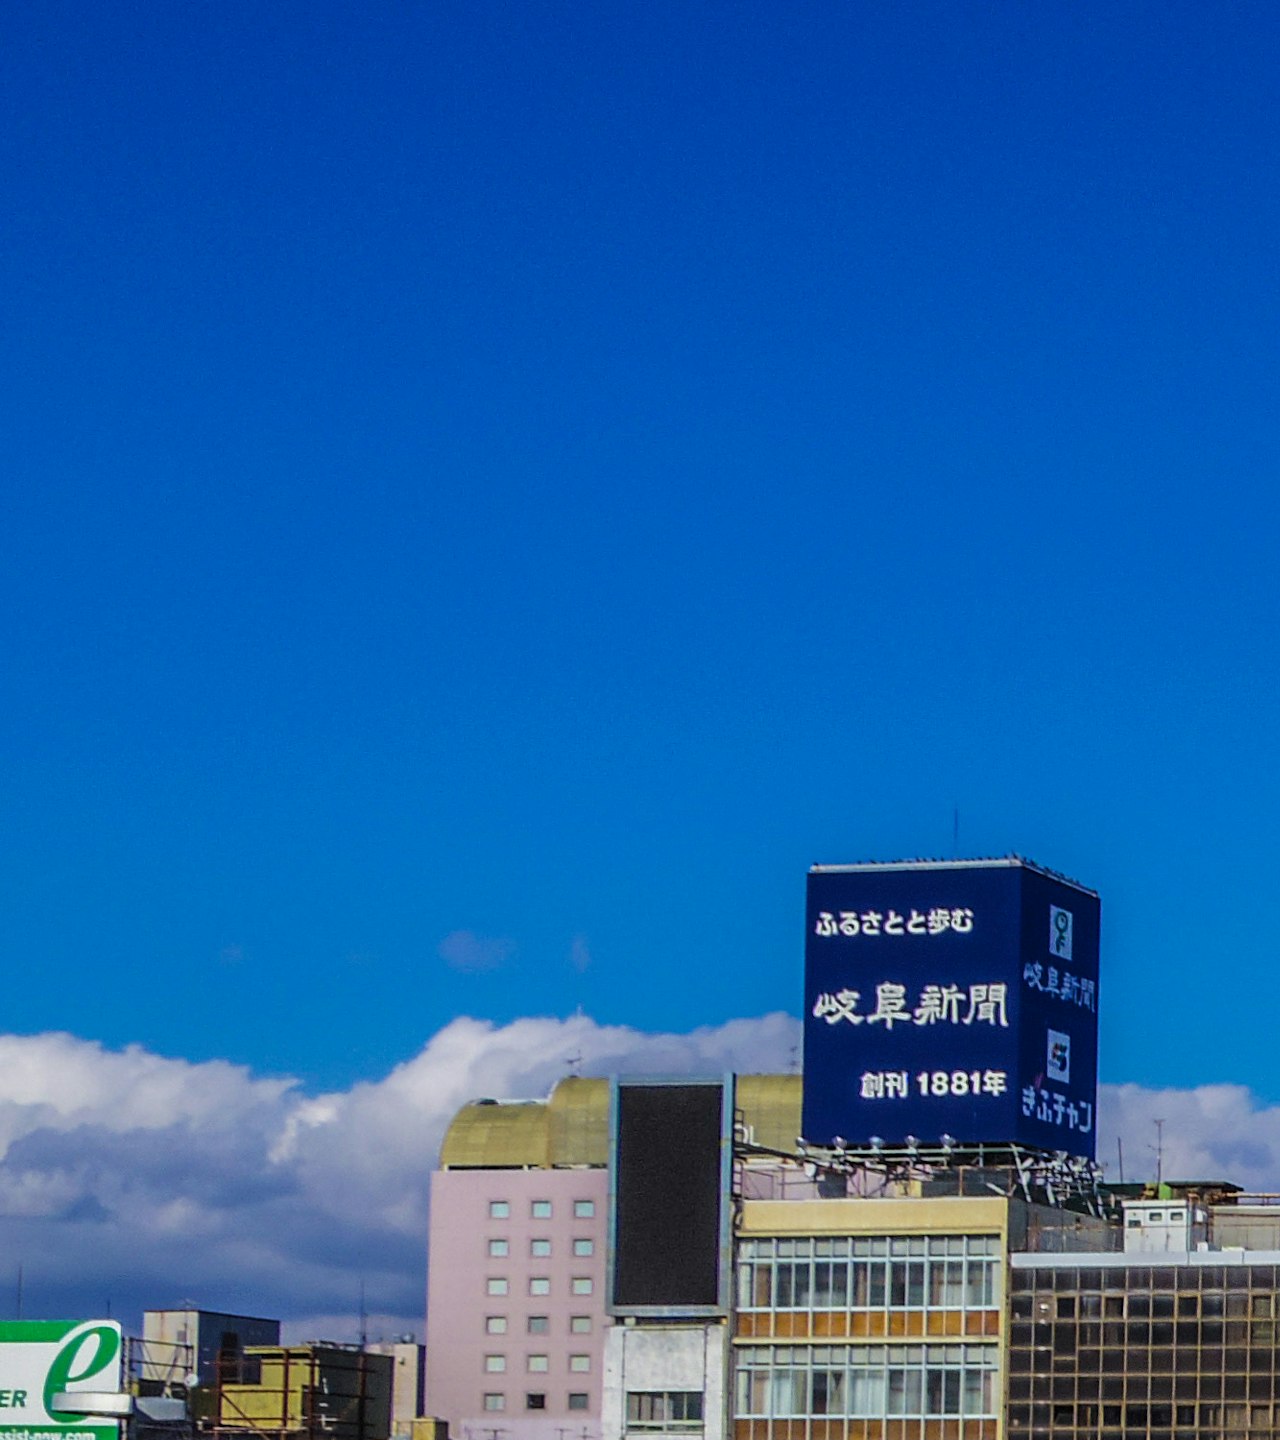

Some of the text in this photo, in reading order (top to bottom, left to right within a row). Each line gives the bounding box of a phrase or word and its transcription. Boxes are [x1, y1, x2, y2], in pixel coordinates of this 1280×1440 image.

[815, 908, 974, 936] ふるさとと歩む
[813, 981, 1009, 1029] 岐阜新聞
[1023, 960, 1095, 1013] 岐阜新聞
[860, 1069, 1008, 1099] 創刊 1881年
